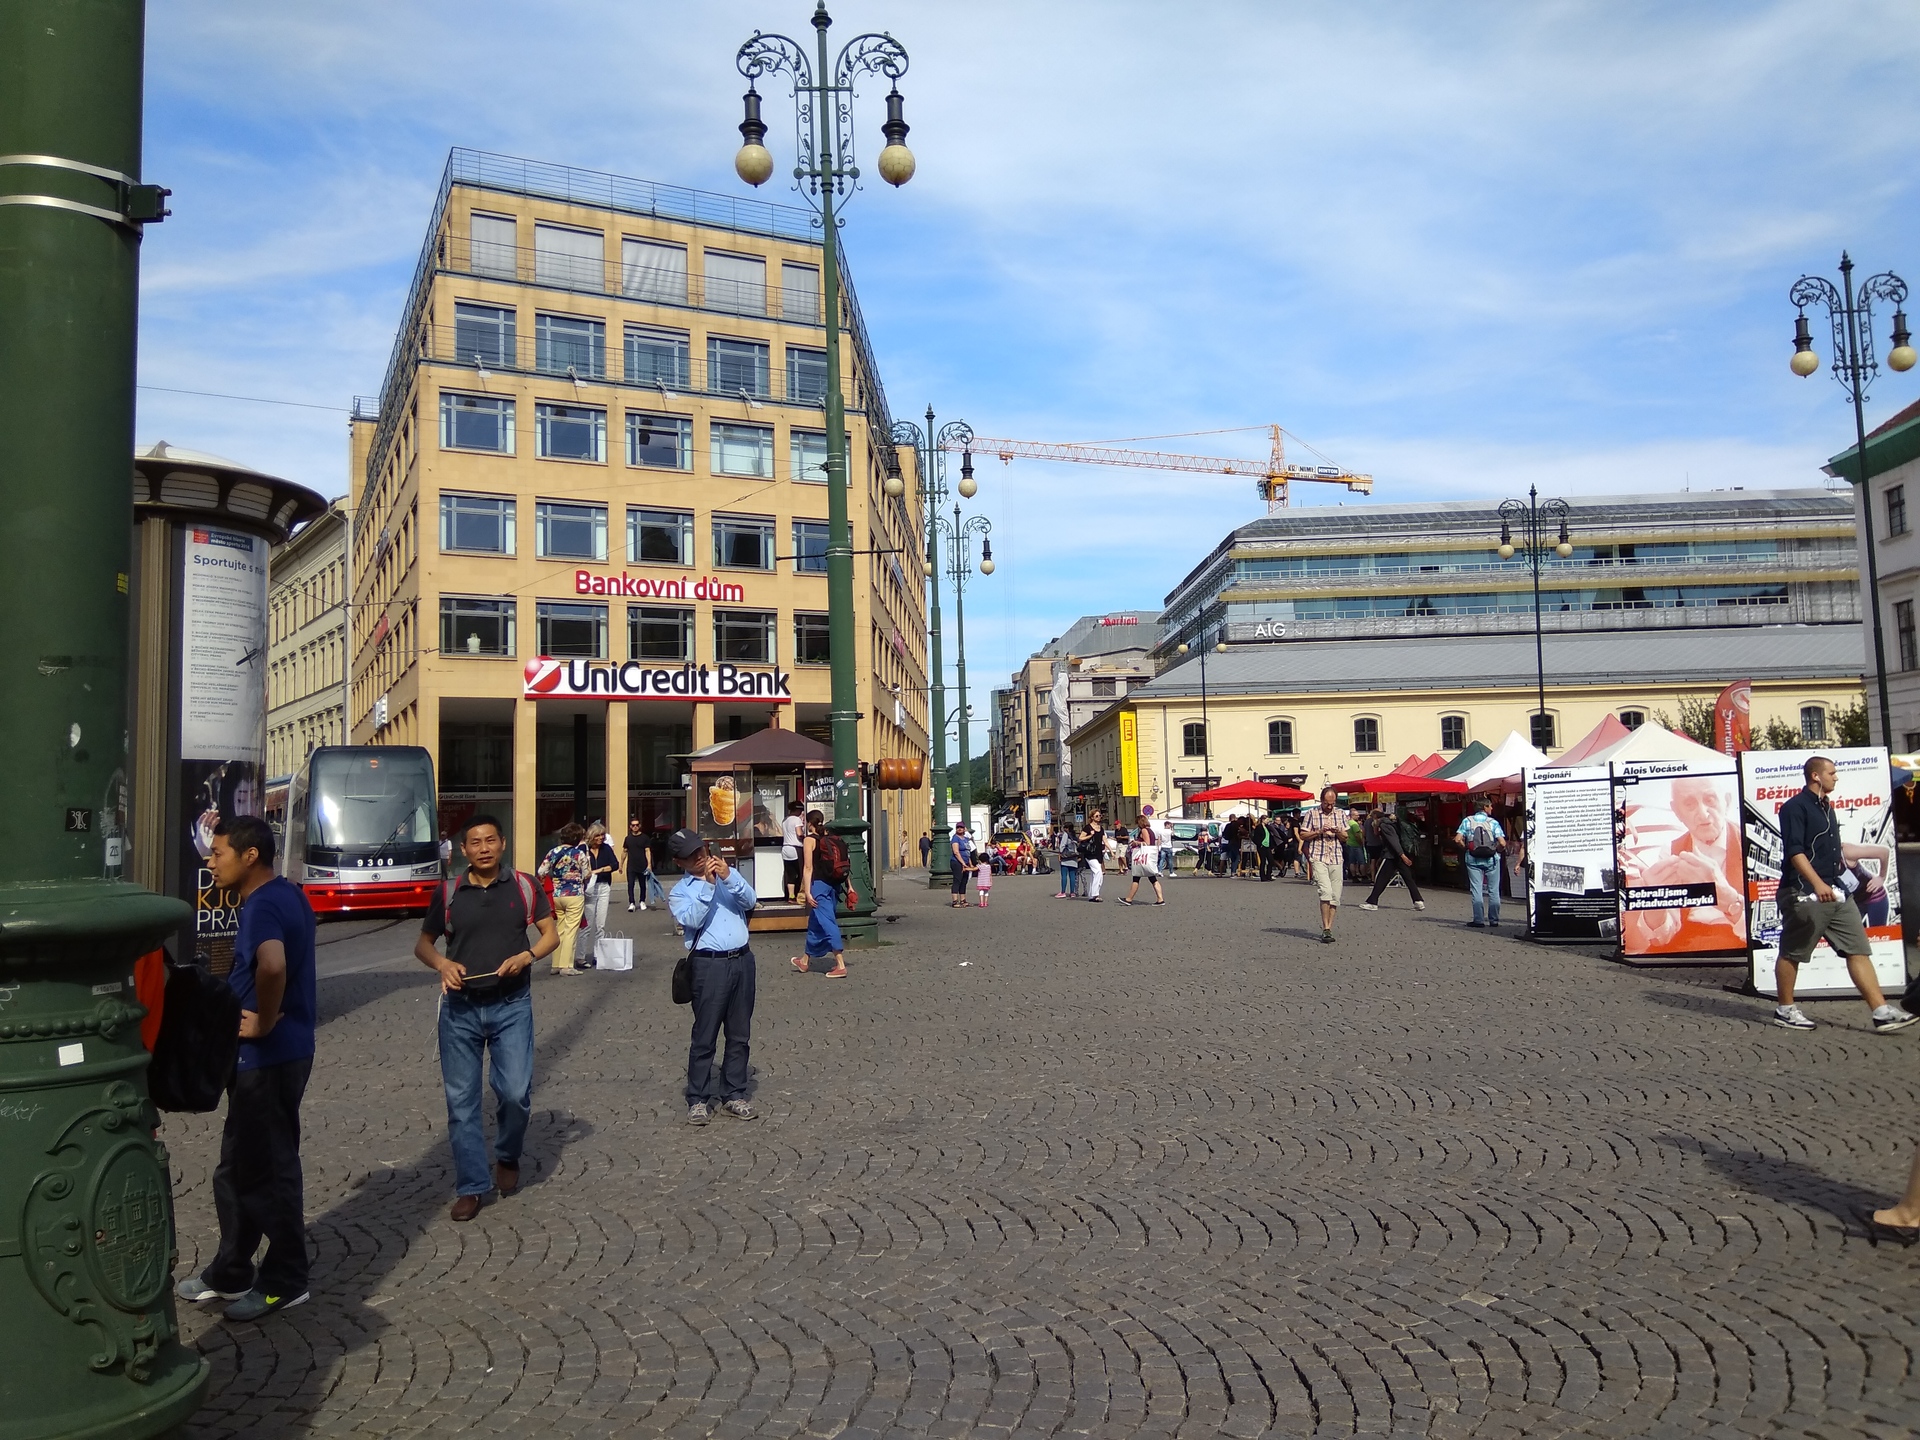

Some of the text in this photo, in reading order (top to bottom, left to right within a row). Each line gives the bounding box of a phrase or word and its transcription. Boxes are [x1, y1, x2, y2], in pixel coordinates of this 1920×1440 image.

[193, 554, 247, 571] Sportujte
[248, 565, 254, 573] s
[575, 569, 745, 601] Bankovní dům
[1101, 616, 1138, 627] Marriott
[1254, 623, 1286, 637] AIG
[567, 658, 792, 696] UniCredit Bank
[1834, 756, 1879, 767] června 2016
[1171, 763, 1400, 774] STARÁ CELNICE
[1623, 764, 1689, 775] Alois Vocásek
[1755, 766, 1778, 774] Obora
[1533, 771, 1572, 781] Legionáři
[806, 787, 823, 801] WITH
[1756, 786, 1804, 801] Běžím
[357, 858, 394, 867] 9300
[1629, 888, 1688, 899] Sebrali jsme
[1629, 897, 1683, 910] pětadvacet
[1683, 893, 1714, 907] jazyků
